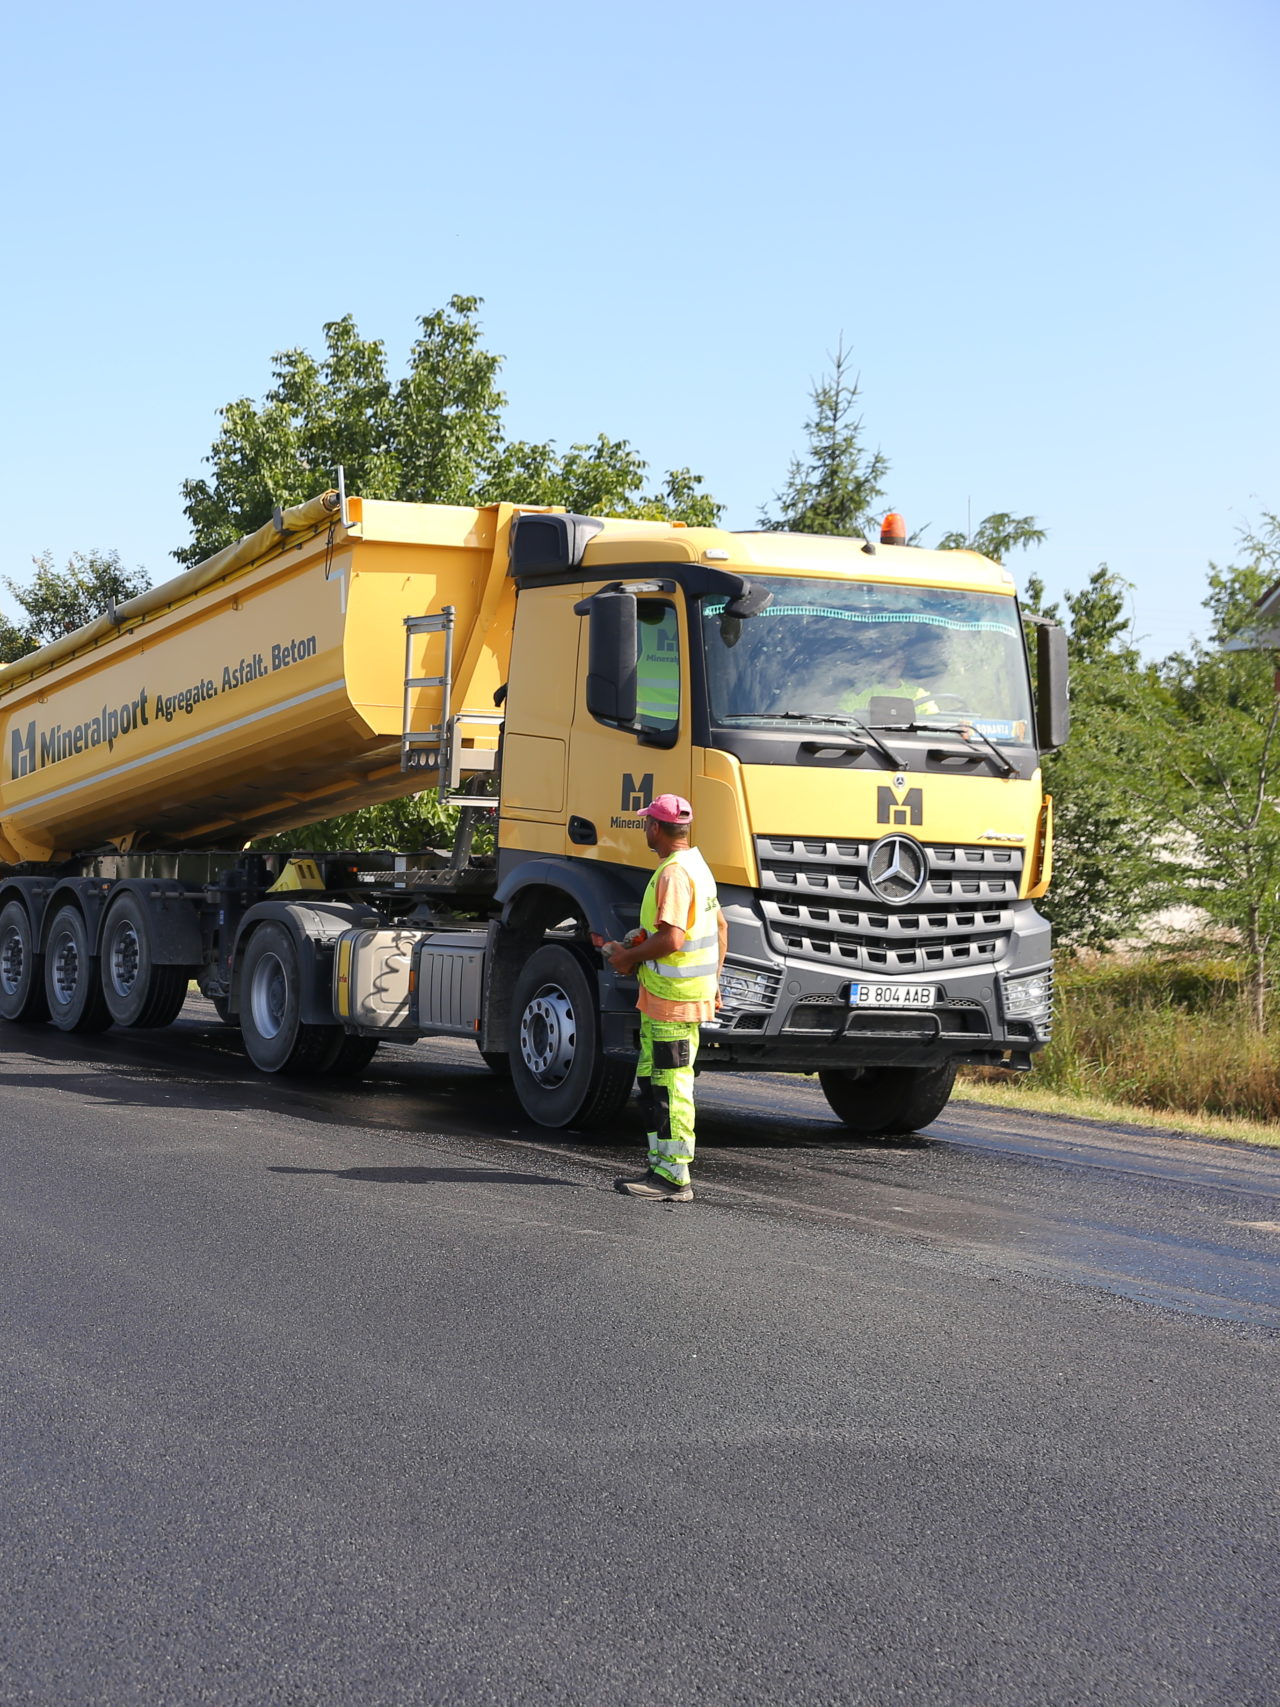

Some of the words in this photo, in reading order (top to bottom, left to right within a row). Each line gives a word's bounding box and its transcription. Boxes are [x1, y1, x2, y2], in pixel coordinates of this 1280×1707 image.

[646, 654, 678, 663] Mineral
[40, 686, 149, 768] Mineralport
[155, 679, 218, 722] Agregate.
[222, 653, 268, 693] Asfalt.
[272, 635, 317, 672] Beton
[860, 986, 870, 1002] B
[875, 987, 901, 1003] 804
[904, 988, 931, 1004] AAB
